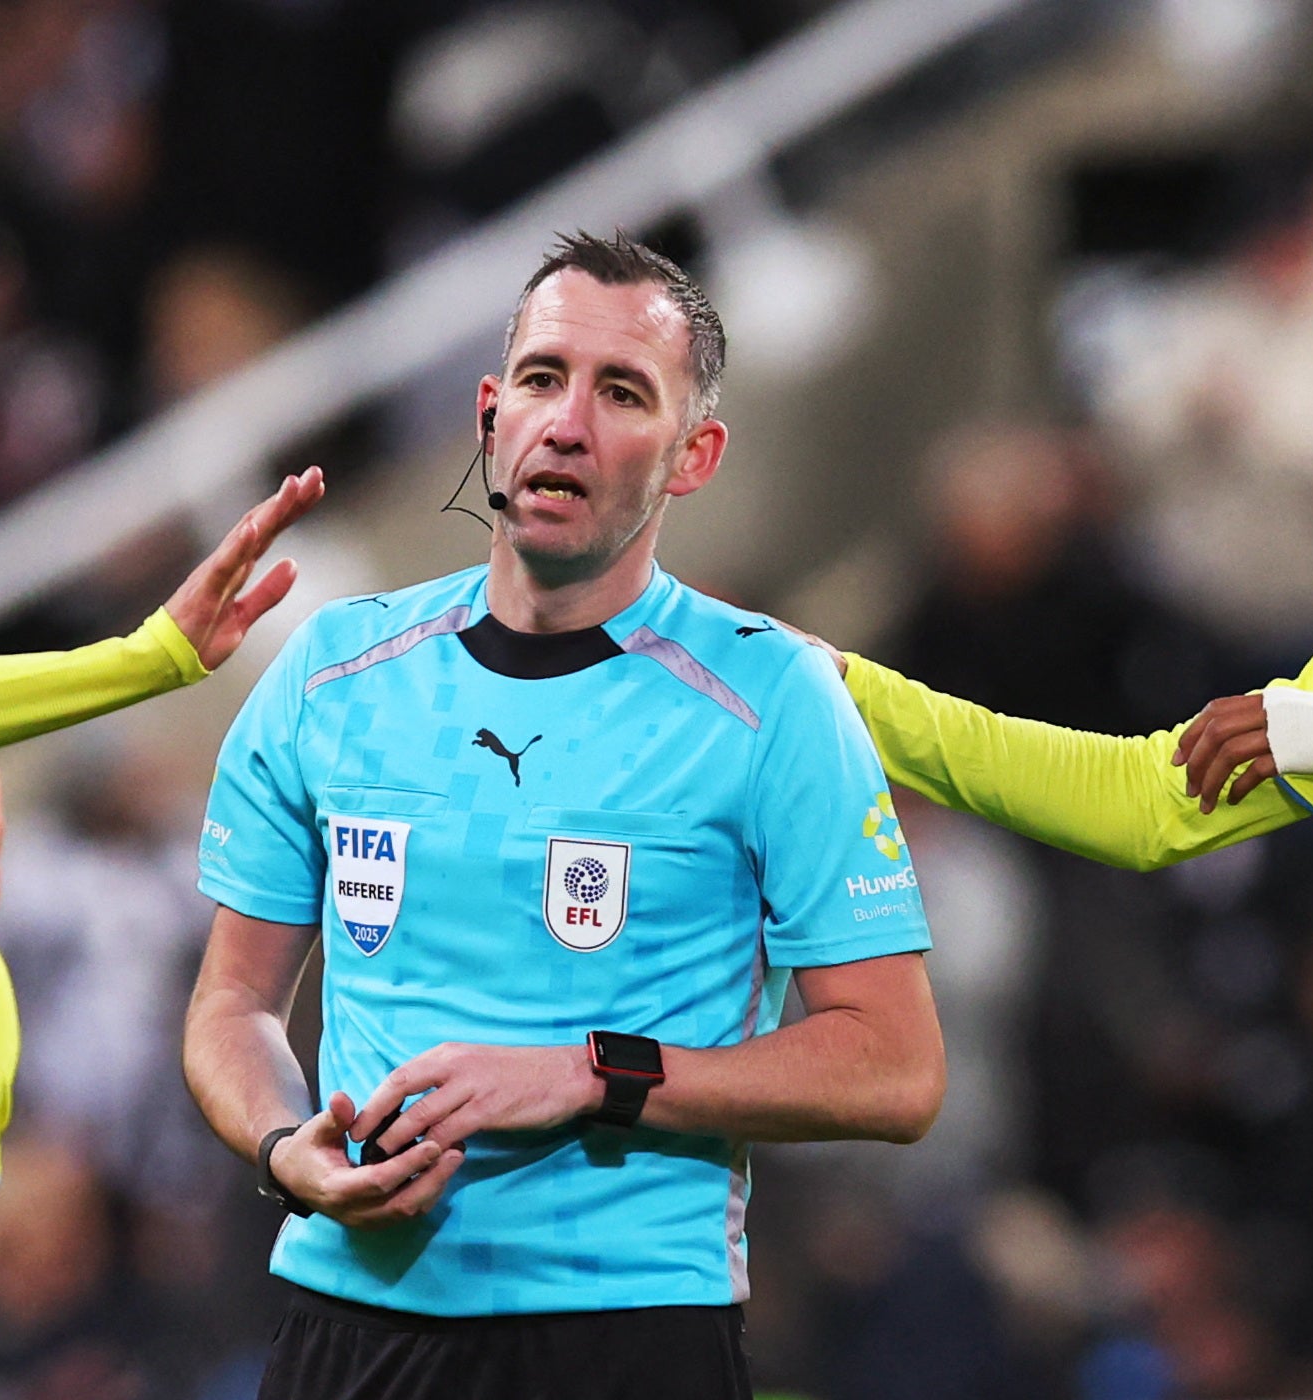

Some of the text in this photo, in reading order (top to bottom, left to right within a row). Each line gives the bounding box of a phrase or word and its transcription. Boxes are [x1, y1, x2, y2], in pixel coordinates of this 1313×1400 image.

[336, 826, 396, 862] FIFA
[338, 880, 395, 902] REFEREE
[566, 906, 603, 928] EFL
[354, 926, 380, 943] 2025
